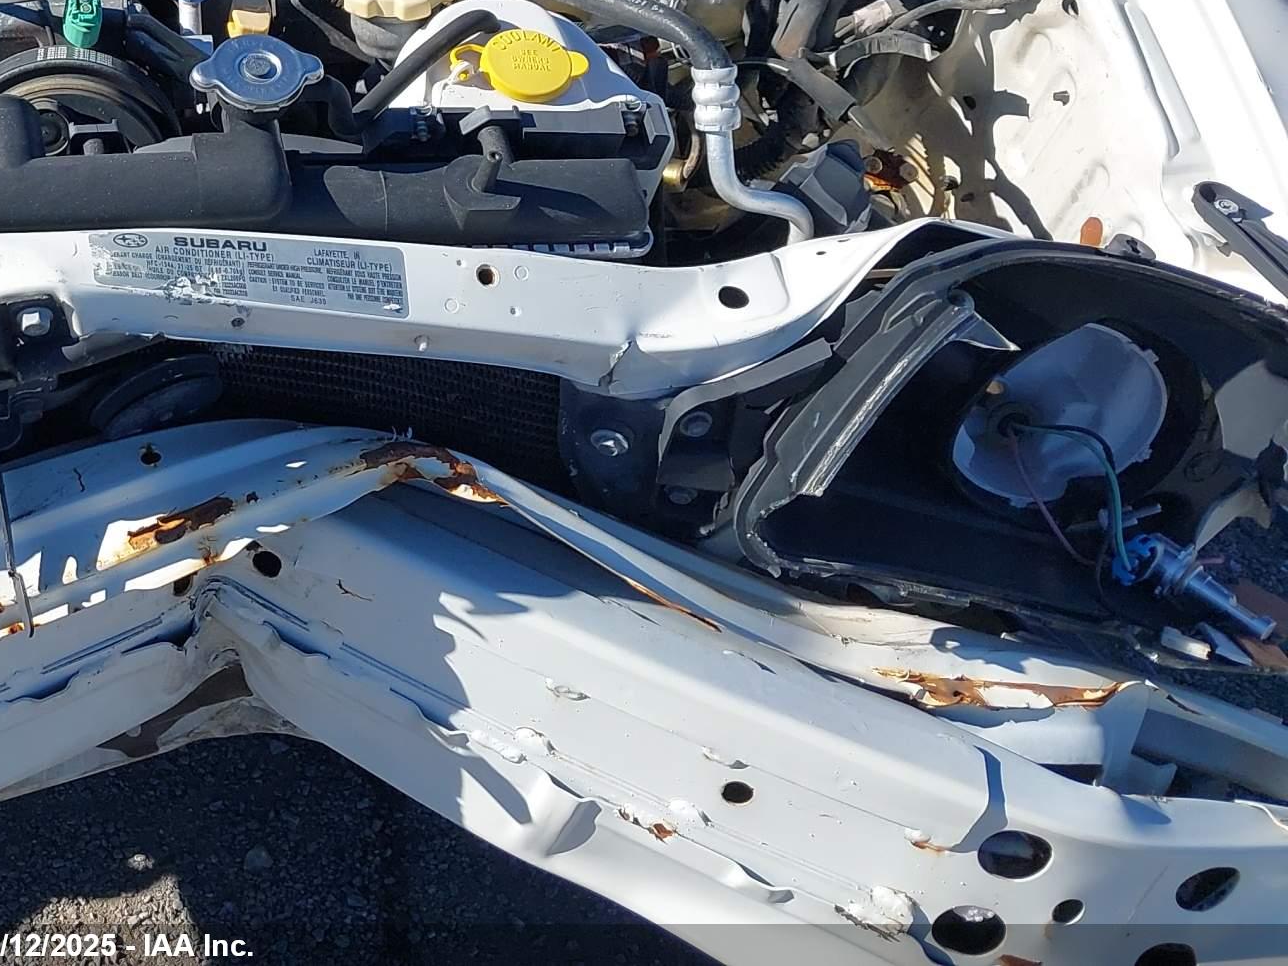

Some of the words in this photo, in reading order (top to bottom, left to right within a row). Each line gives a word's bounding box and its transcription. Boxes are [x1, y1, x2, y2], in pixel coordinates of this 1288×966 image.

[492, 30, 562, 53] COOLANT
[173, 236, 268, 251] SUBARU
[155, 245, 170, 253] AIR
[173, 247, 232, 259] CONDITIONER
[234, 250, 274, 262] (LI-TYPE)
[306, 257, 356, 269] CLIMATISEUR
[357, 261, 393, 273] (LI-TYPE)
[290, 294, 305, 303] SAE
